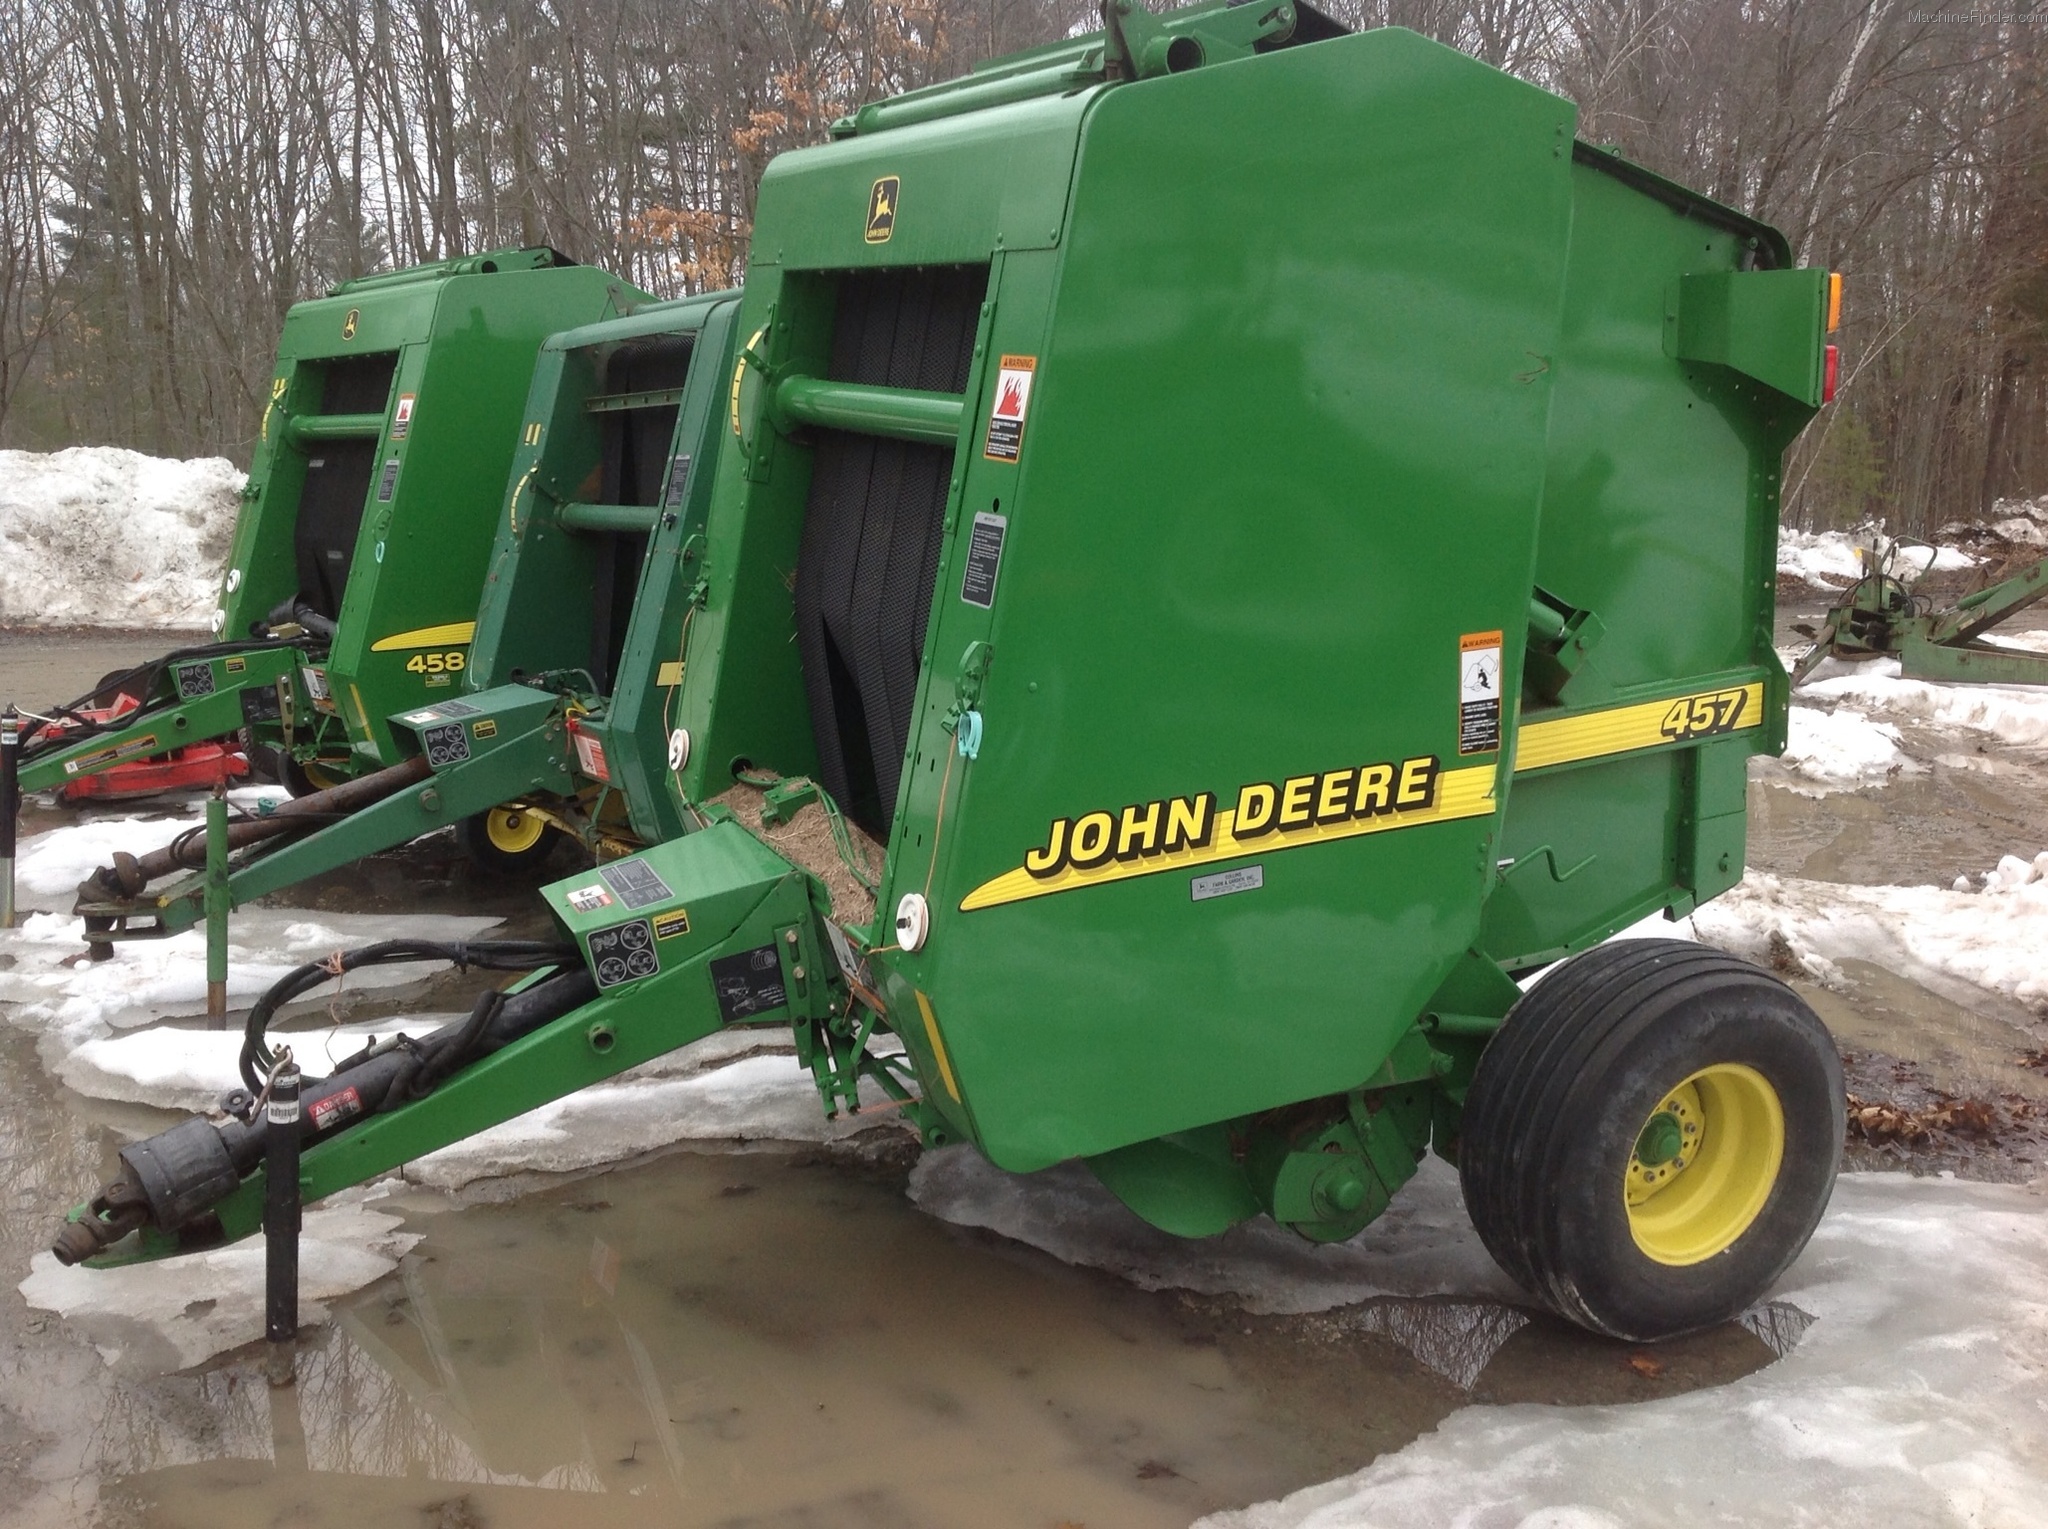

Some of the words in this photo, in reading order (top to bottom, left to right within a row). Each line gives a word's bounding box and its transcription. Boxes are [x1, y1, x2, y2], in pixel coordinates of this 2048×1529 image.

[1008, 359, 1032, 368] WARNING
[1468, 637, 1500, 647] WARNING
[407, 652, 465, 673] 458
[1661, 689, 1746, 739] 457
[1025, 792, 1214, 877] JOHN
[1232, 755, 1438, 837] DEERE
